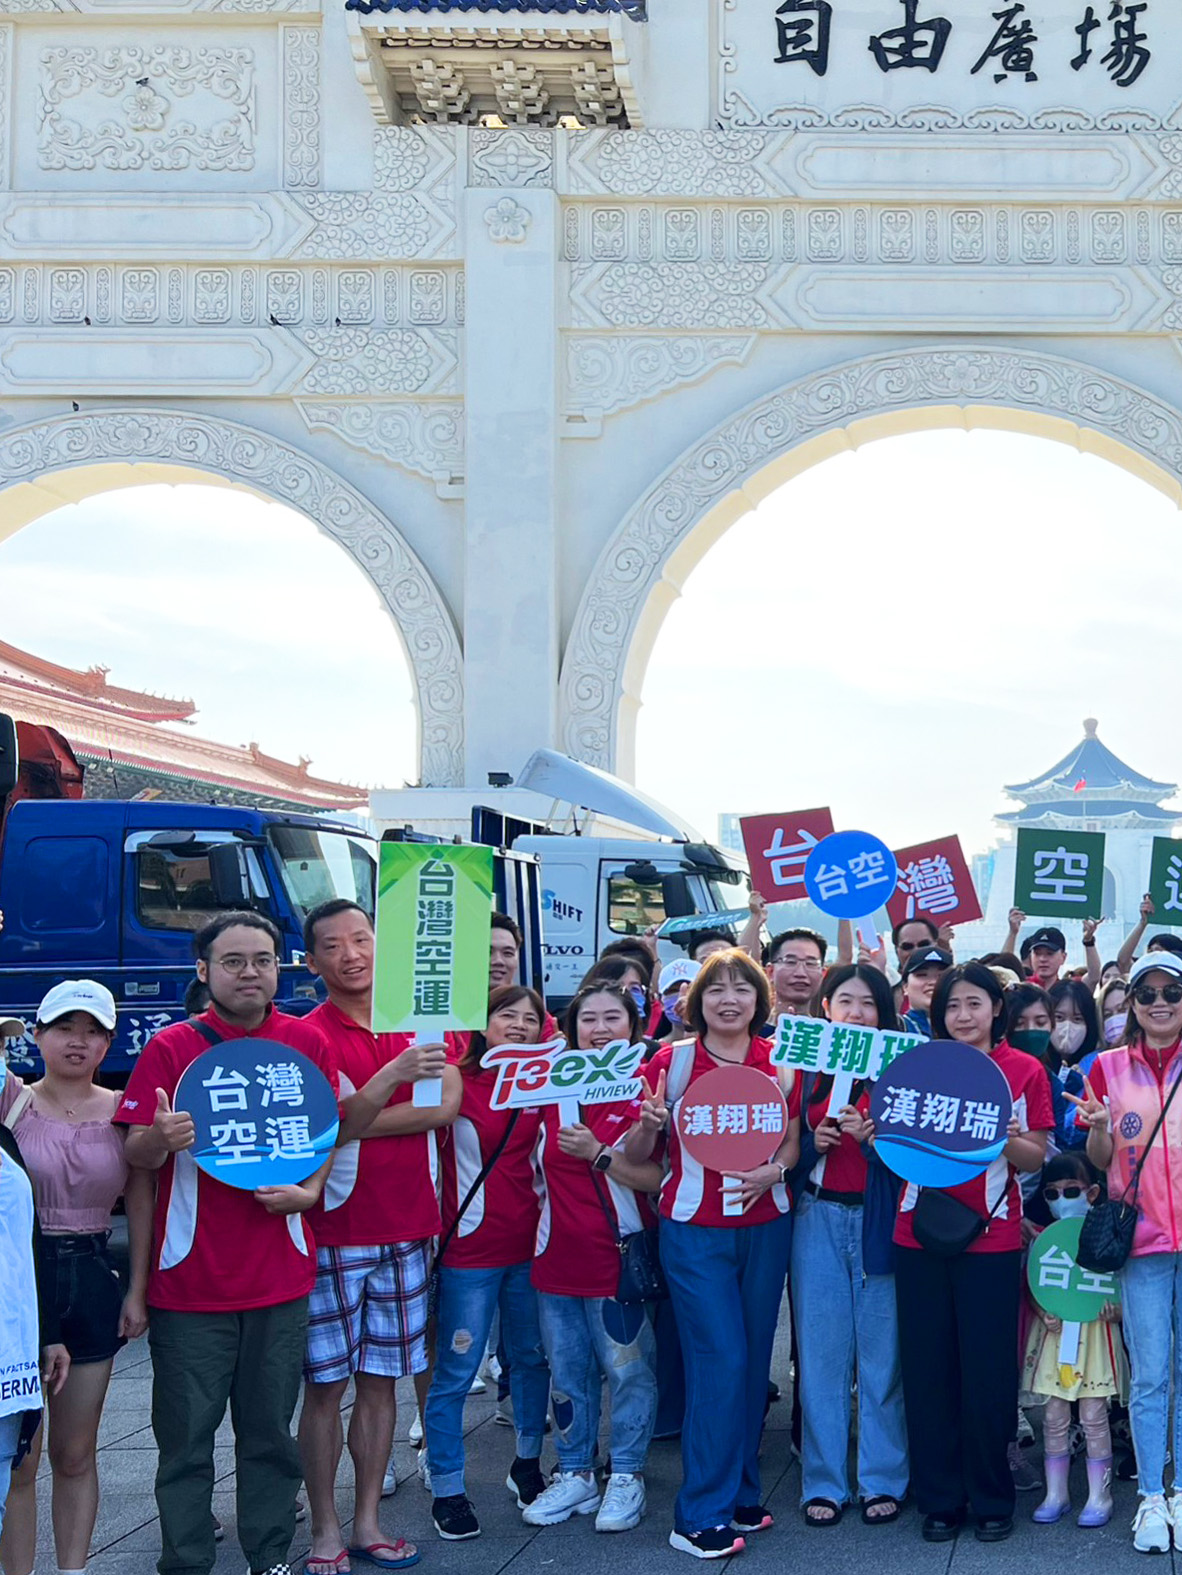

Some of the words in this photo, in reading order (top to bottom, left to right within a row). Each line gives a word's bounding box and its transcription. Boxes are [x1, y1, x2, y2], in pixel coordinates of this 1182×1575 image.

[774, 0, 1151, 87] 自由廣場
[763, 827, 821, 886] 台
[814, 849, 890, 901] 台空
[1030, 846, 1089, 903] 空
[896, 853, 960, 920] 灣
[413, 859, 455, 1016] 台灣空運
[202, 1061, 305, 1112] 台灣
[583, 1082, 638, 1100] HIVIEW
[879, 1085, 1001, 1141] 漢翔瑞
[209, 1115, 316, 1166] 空運
[683, 1102, 784, 1136] 漢翔瑞
